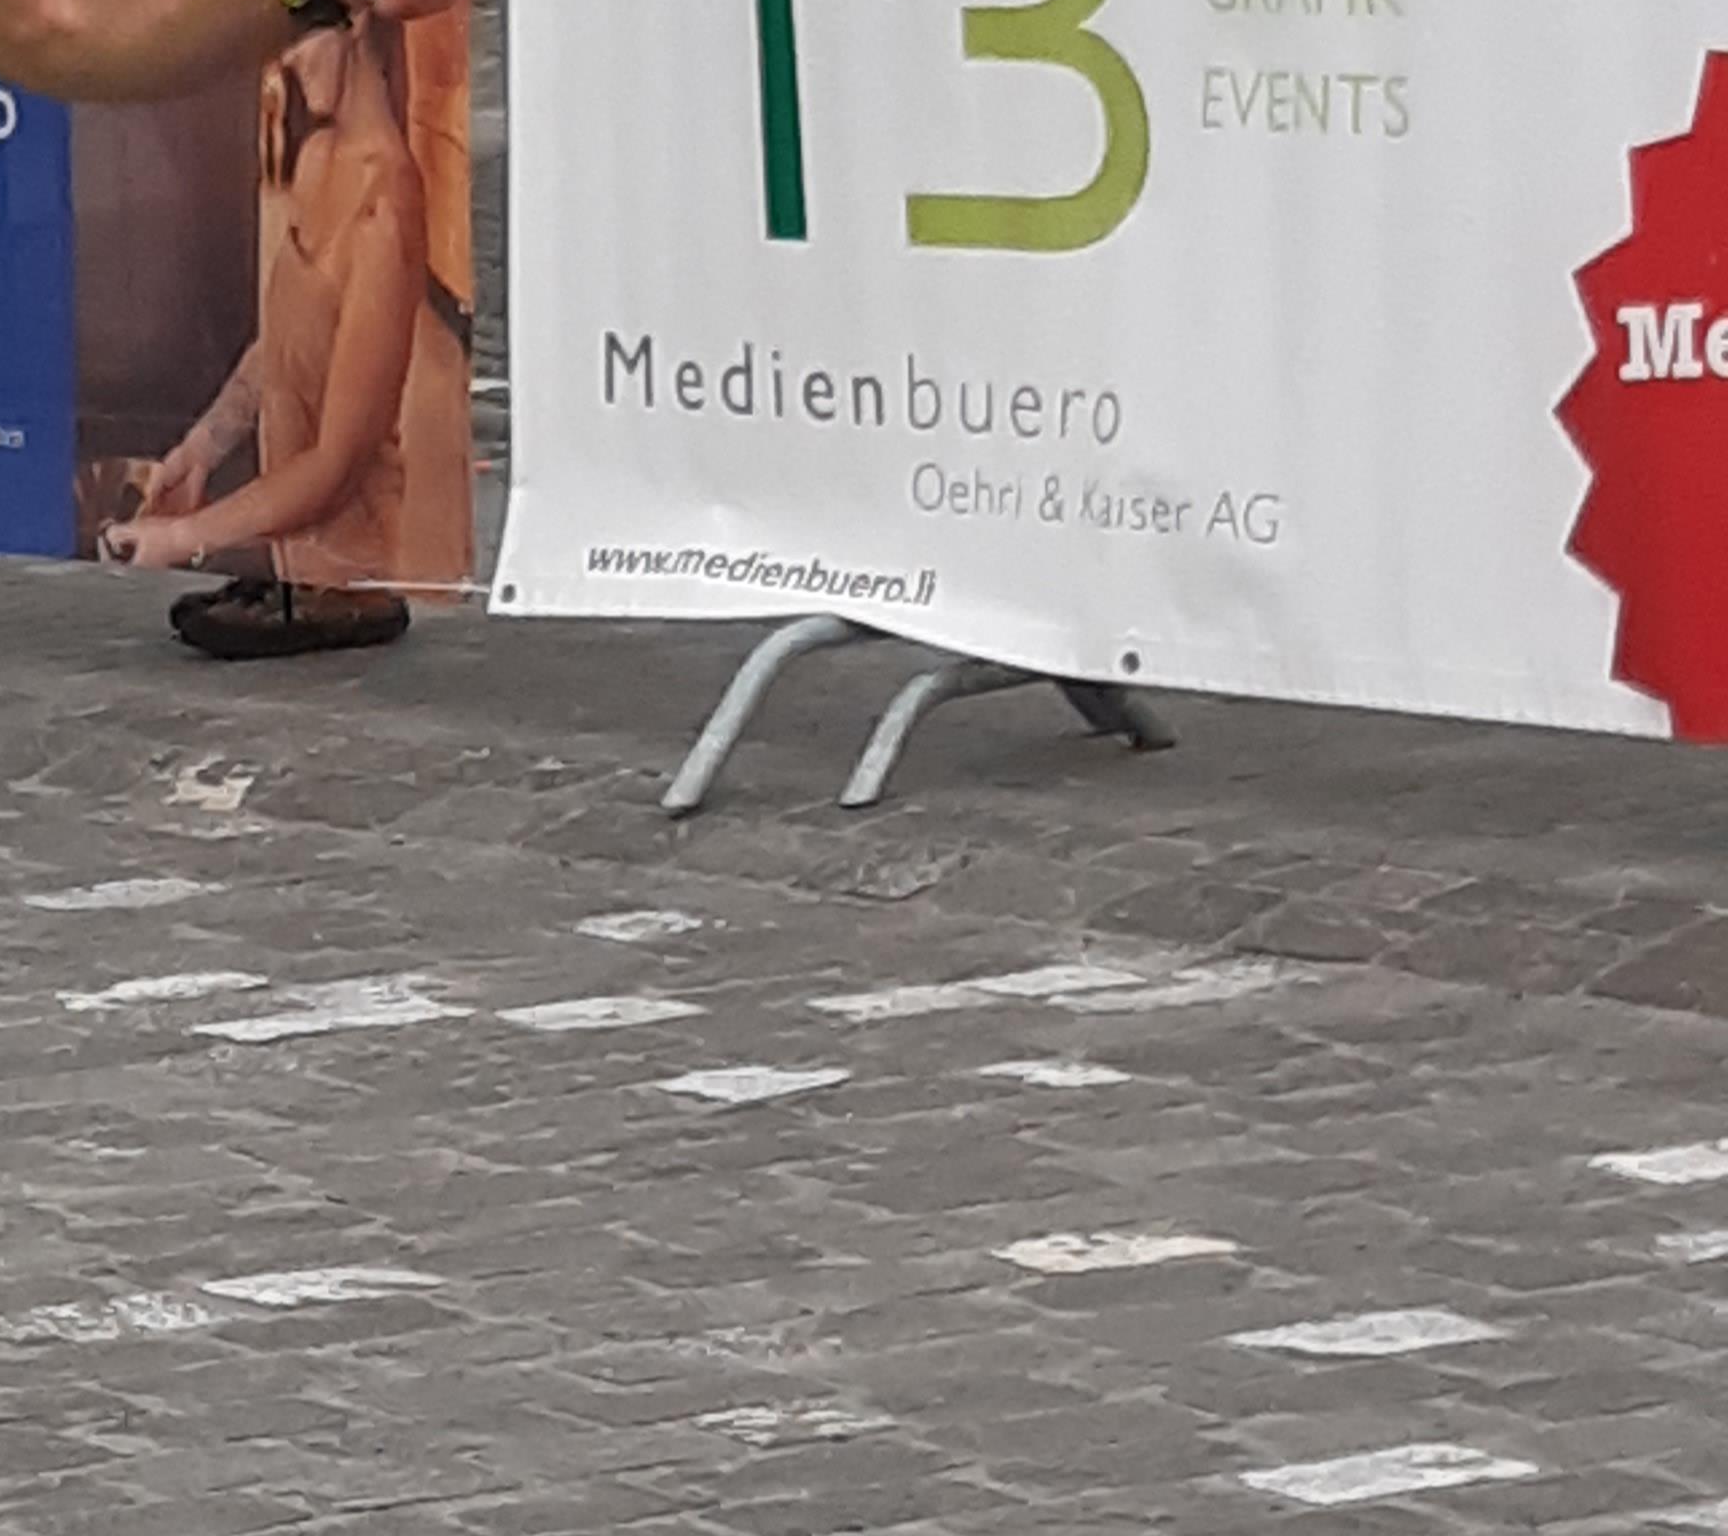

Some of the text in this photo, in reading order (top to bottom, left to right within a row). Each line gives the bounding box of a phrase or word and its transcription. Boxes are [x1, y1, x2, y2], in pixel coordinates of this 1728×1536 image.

[1202, 65, 1410, 139] EVENTS
[603, 331, 1122, 445] Medienbuero
[911, 462, 1281, 545] Oehri & Kaiser AG
